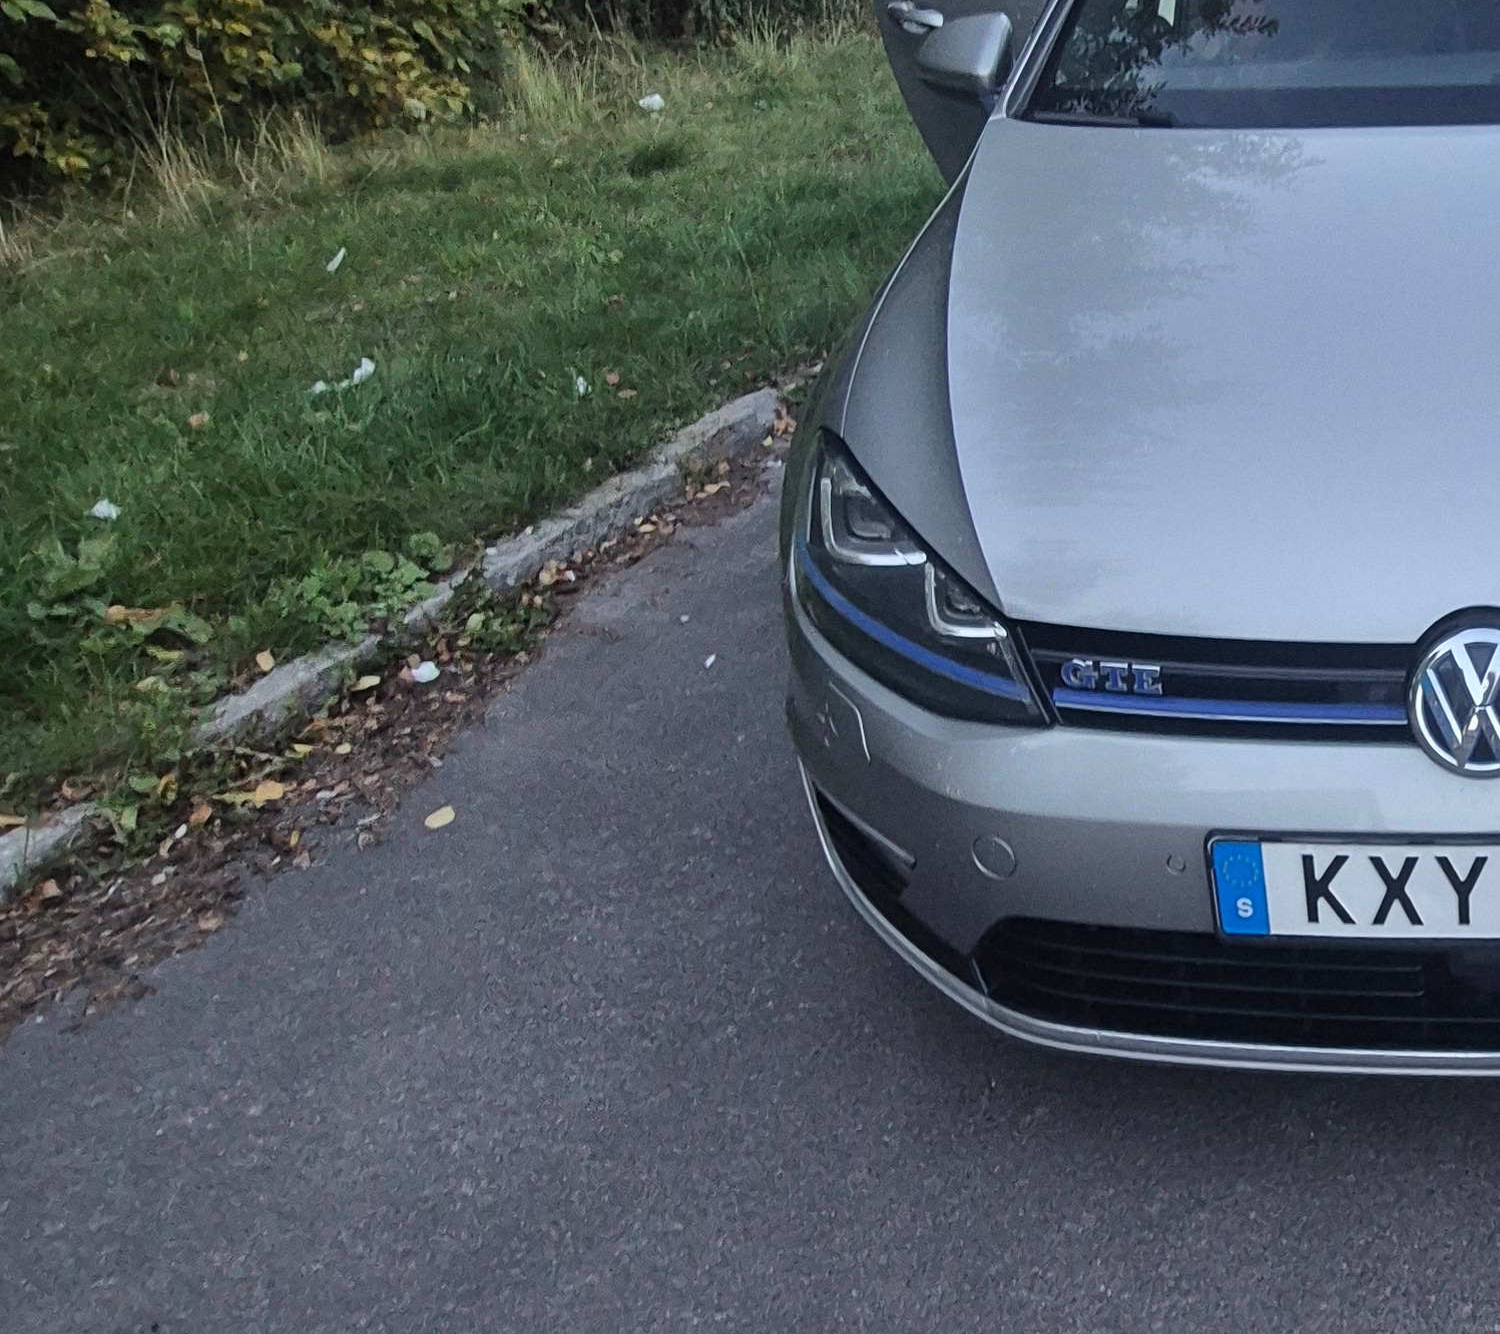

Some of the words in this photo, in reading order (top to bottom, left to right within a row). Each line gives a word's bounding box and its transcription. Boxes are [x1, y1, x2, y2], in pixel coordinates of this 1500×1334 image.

[1061, 658, 1162, 695] GTE
[1236, 897, 1254, 918] S
[1299, 854, 1489, 927] KXY
